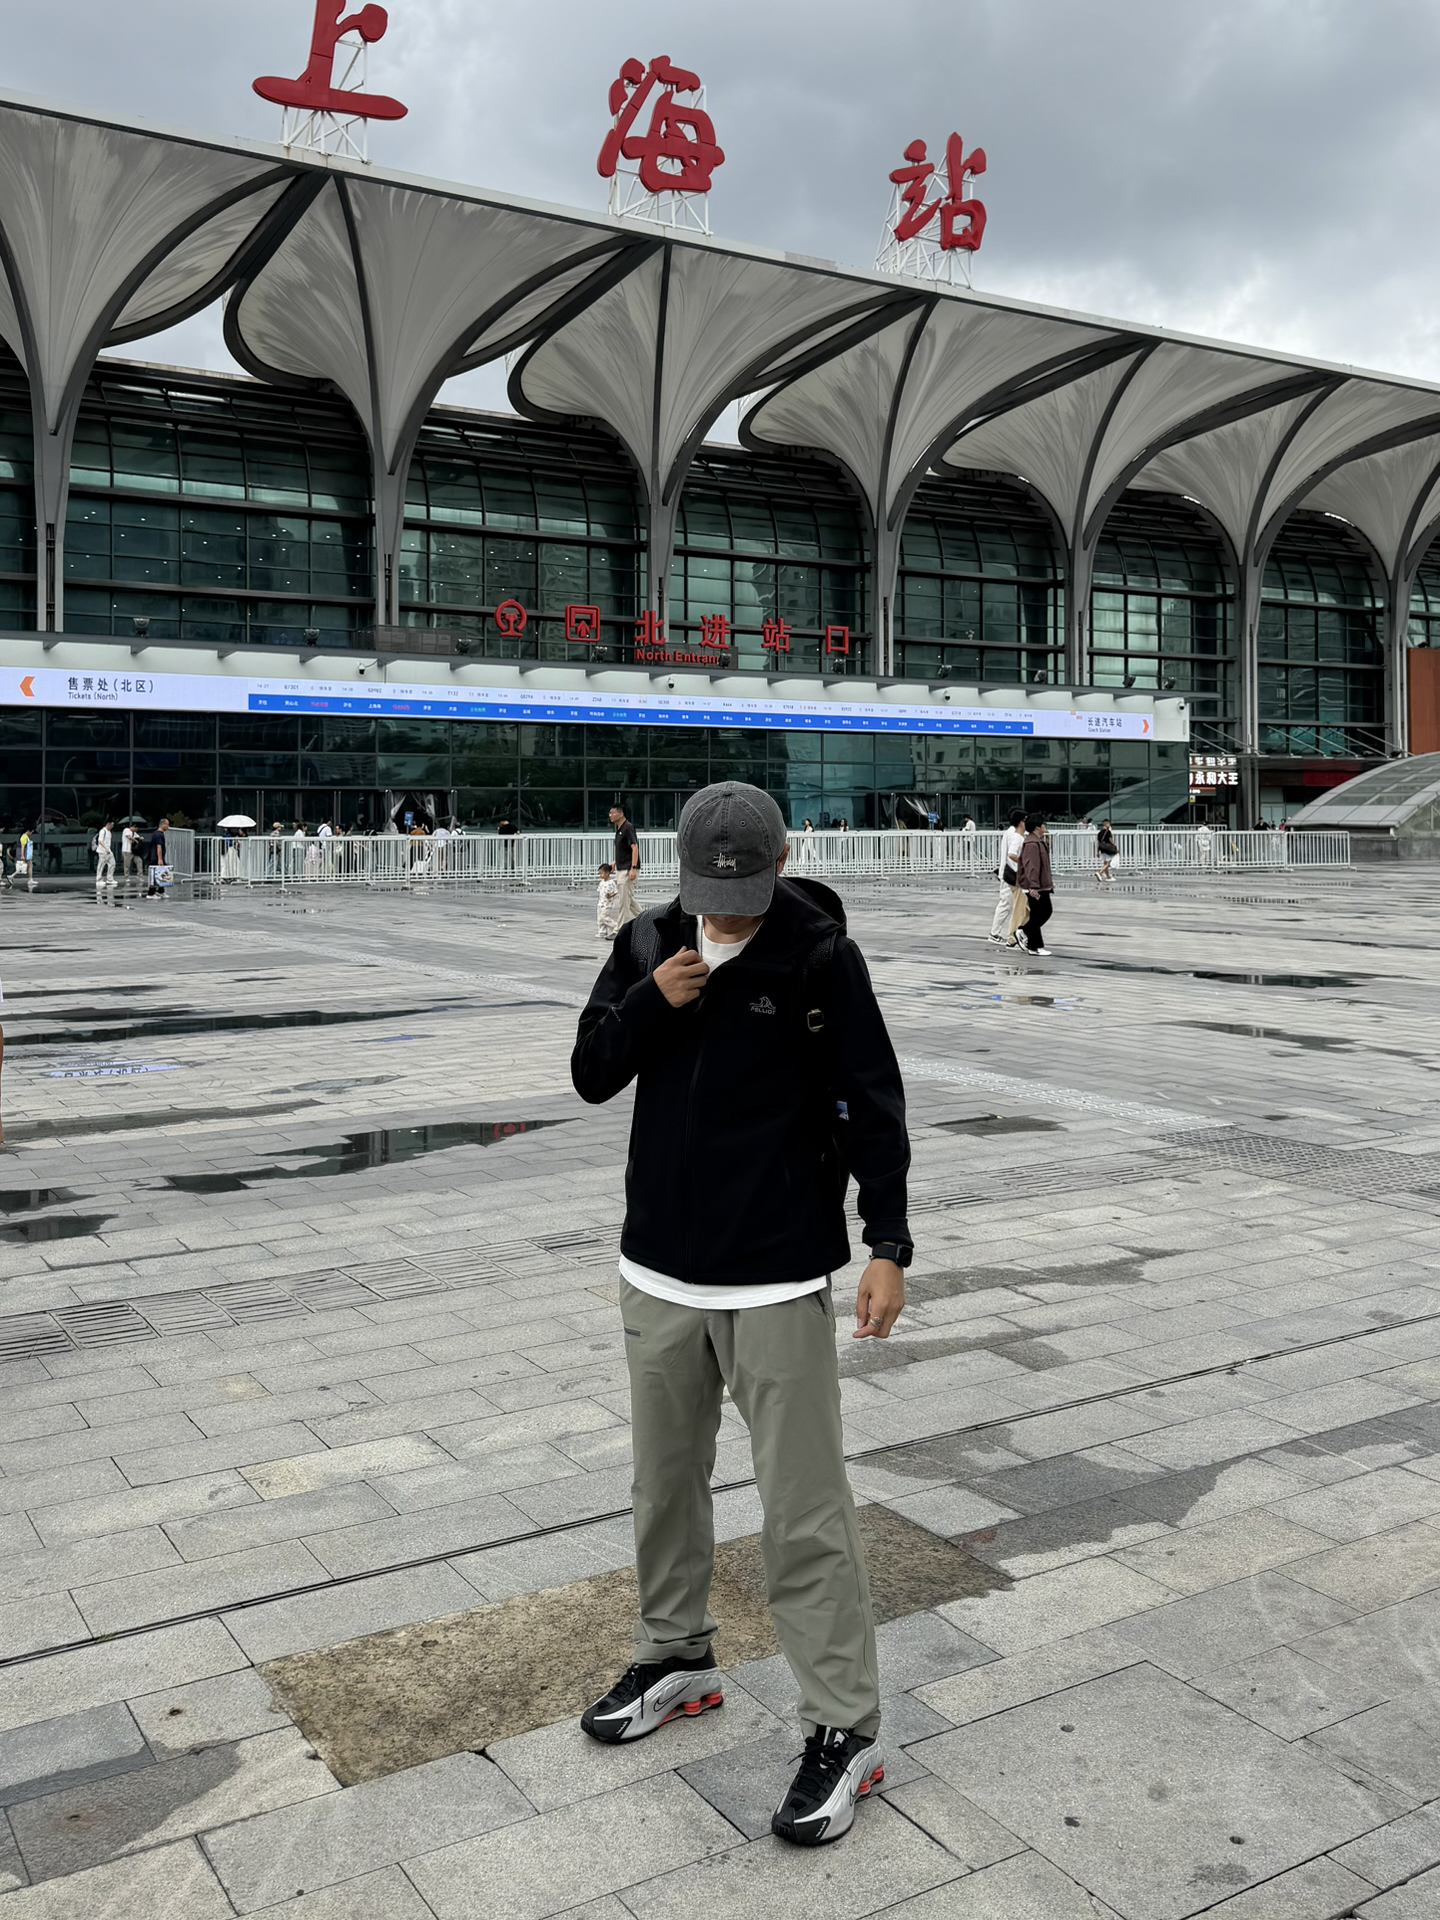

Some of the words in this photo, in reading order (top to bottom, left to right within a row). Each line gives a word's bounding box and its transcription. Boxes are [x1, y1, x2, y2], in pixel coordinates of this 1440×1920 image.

[252, 0, 988, 252] 上海站
[634, 610, 849, 654] 北进站口
[635, 648, 671, 662] North
[674, 651, 719, 664] Entran
[68, 677, 154, 693] 售票处(北区)
[68, 692, 91, 700] Tickets
[94, 692, 118, 701] (North)
[1195, 771, 1239, 785] 永和大王
